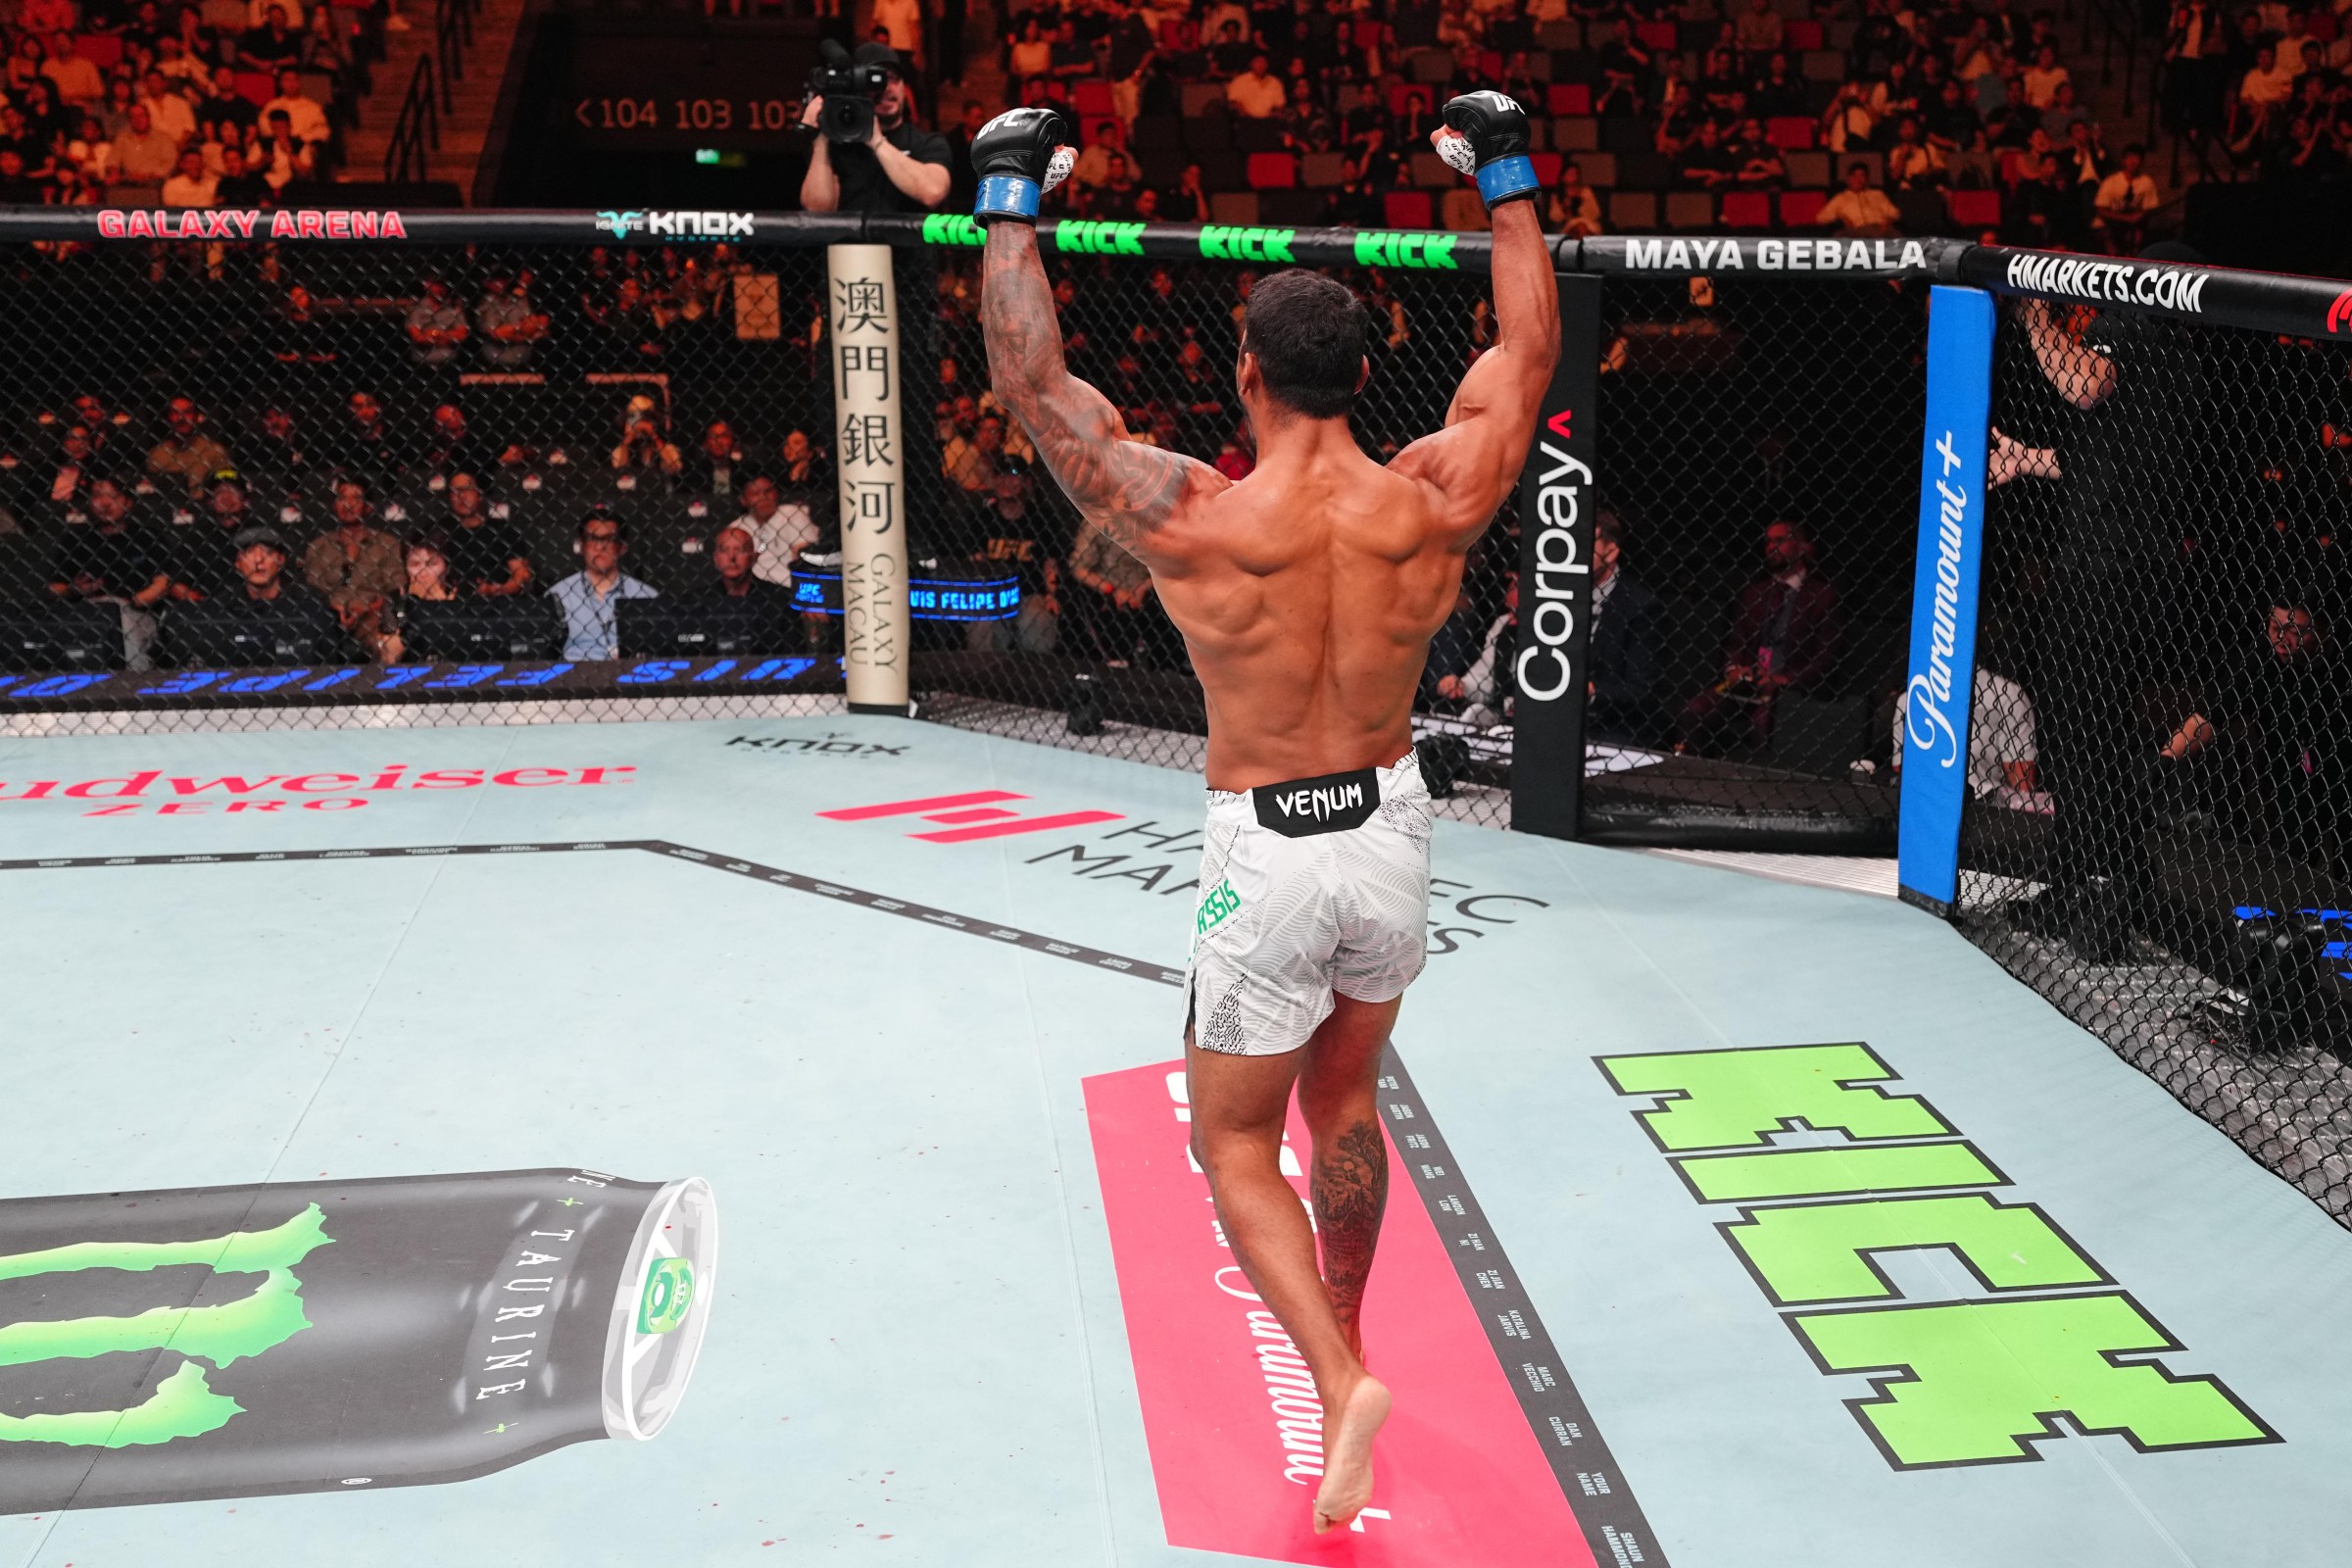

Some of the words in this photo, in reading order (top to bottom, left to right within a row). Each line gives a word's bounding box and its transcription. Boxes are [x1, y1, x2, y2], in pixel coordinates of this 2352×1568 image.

[601, 99, 658, 128] 104
[675, 100, 733, 129] 103
[1492, 94, 1525, 115] UF
[97, 209, 261, 238] GALAXY
[270, 210, 408, 239] ARENA
[649, 212, 755, 236] KNOX
[923, 214, 988, 246] KIC
[1055, 220, 1147, 255] KICK
[1199, 225, 1296, 263] KICK
[1354, 232, 1458, 270] KICK
[1625, 239, 1744, 270] MAYA
[1756, 239, 1928, 270] GEBALA
[2007, 254, 2210, 314] HMARKETS.COM
[834, 277, 896, 535] 澳門銀河
[1517, 441, 1592, 702] Corpay
[910, 590, 936, 608] UIS
[941, 592, 996, 610] FELIPE
[1906, 429, 1968, 769] Paramount+
[847, 562, 868, 665] MACAU
[870, 553, 898, 675] GALAXY
[617, 657, 847, 684] UIS
[725, 736, 911, 756] KNOX
[81, 798, 369, 816] ZERO
[1275, 782, 1363, 822] VENUM
[1389, 1103, 1404, 1120] AUSTIN
[1399, 1103, 1415, 1119] JASON
[1405, 1134, 1420, 1149] FRITZ
[1415, 1133, 1431, 1149] JASON
[1421, 1164, 1435, 1180] WANG
[1433, 1165, 1446, 1176] WEI
[1439, 1200, 1452, 1211] LOW
[1447, 1195, 1466, 1216] LANDON
[1470, 1239, 1485, 1251] HAN
[1590, 1041, 2288, 1472] KICK
[1476, 1272, 1493, 1289] CHEN
[1490, 1274, 1505, 1290] JIAN
[475, 1229, 575, 1400] TAURINE
[1497, 1314, 1517, 1337] JARVIS
[1507, 1309, 1532, 1341] KATALINA
[1522, 1362, 1545, 1393] VECCHIO
[1537, 1366, 1556, 1387] MARC
[1548, 1416, 1572, 1446] CURRAN
[1565, 1422, 1583, 1438] DAN
[1576, 1472, 1597, 1496] NAME
[1592, 1472, 1611, 1494] YOUR
[1620, 1532, 1644, 1562] SHAUN
